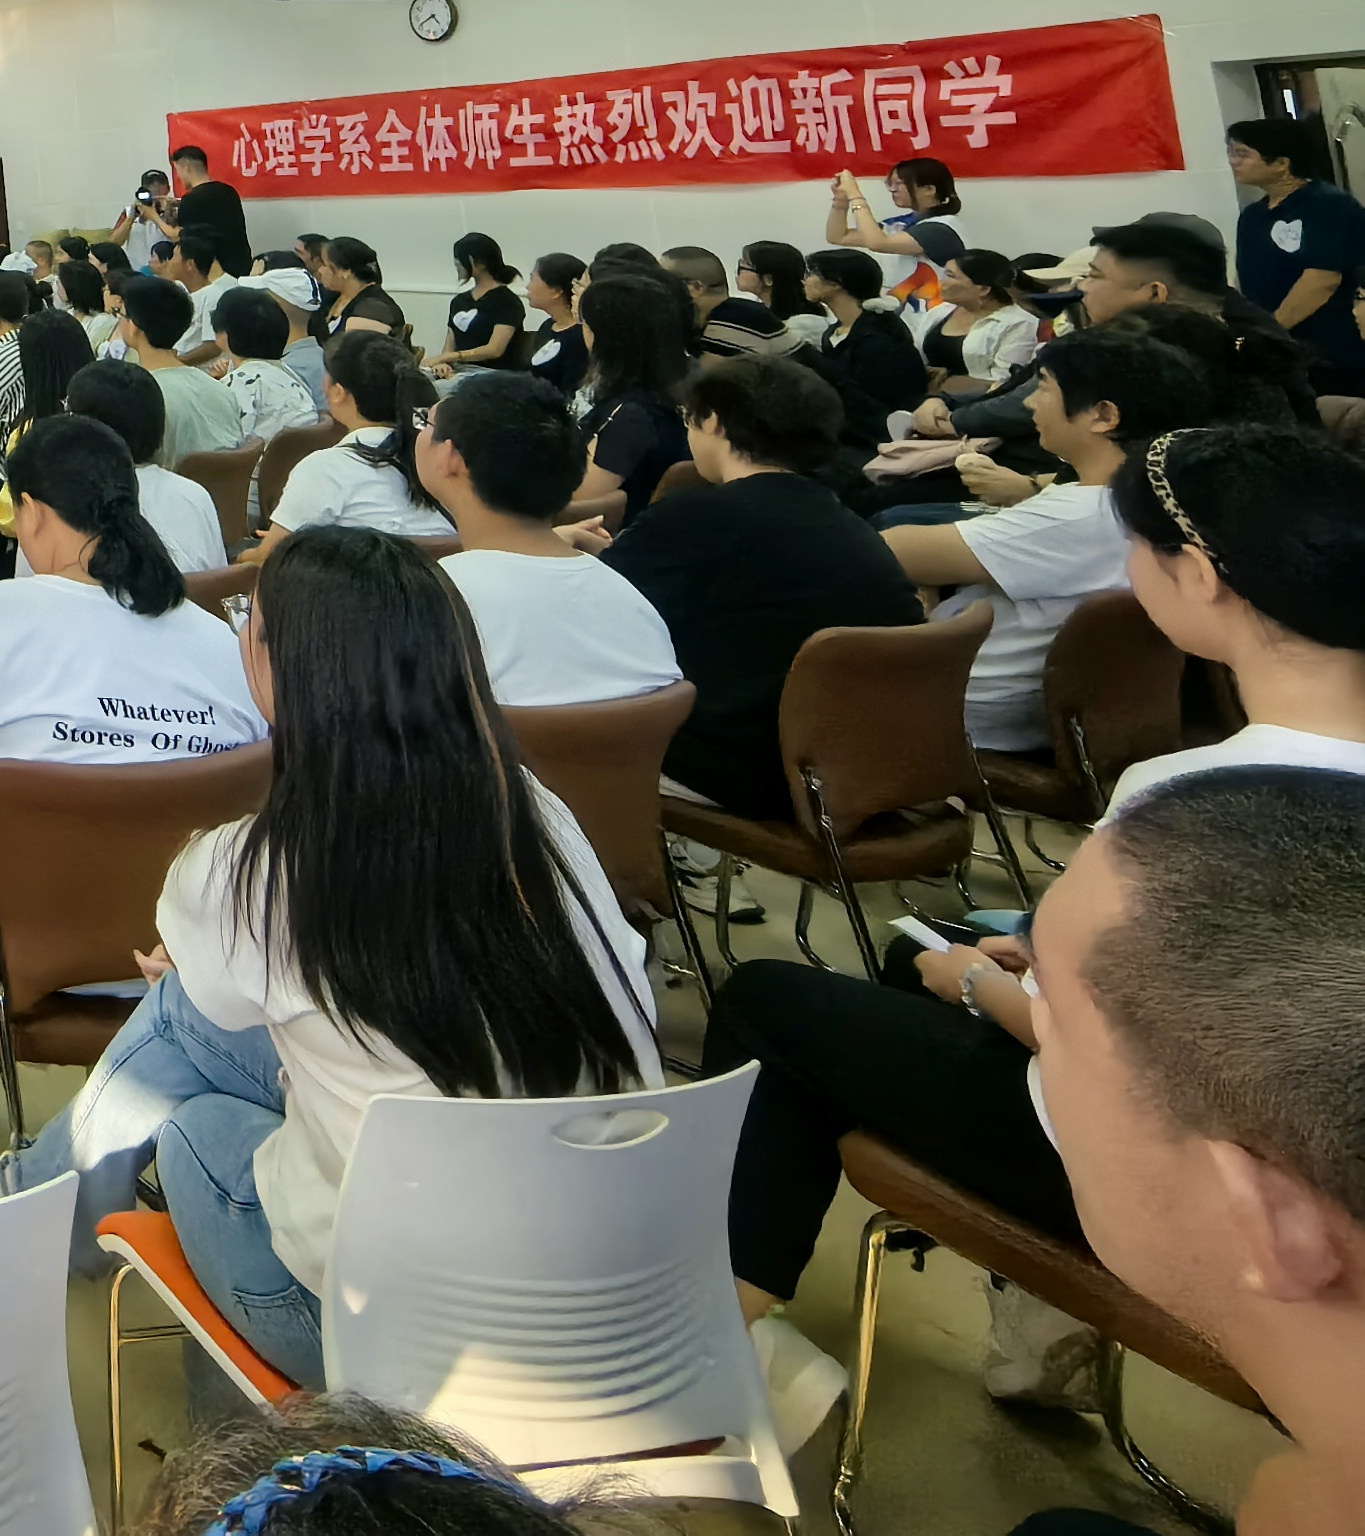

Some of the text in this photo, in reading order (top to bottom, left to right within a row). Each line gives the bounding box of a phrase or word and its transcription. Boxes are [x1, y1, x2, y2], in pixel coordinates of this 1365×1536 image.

[232, 54, 1017, 178] 心理学系全体师生热烈欢迎新同学
[97, 697, 216, 726] Whatever!
[52, 721, 135, 748] Stores
[151, 732, 183, 751] Of
